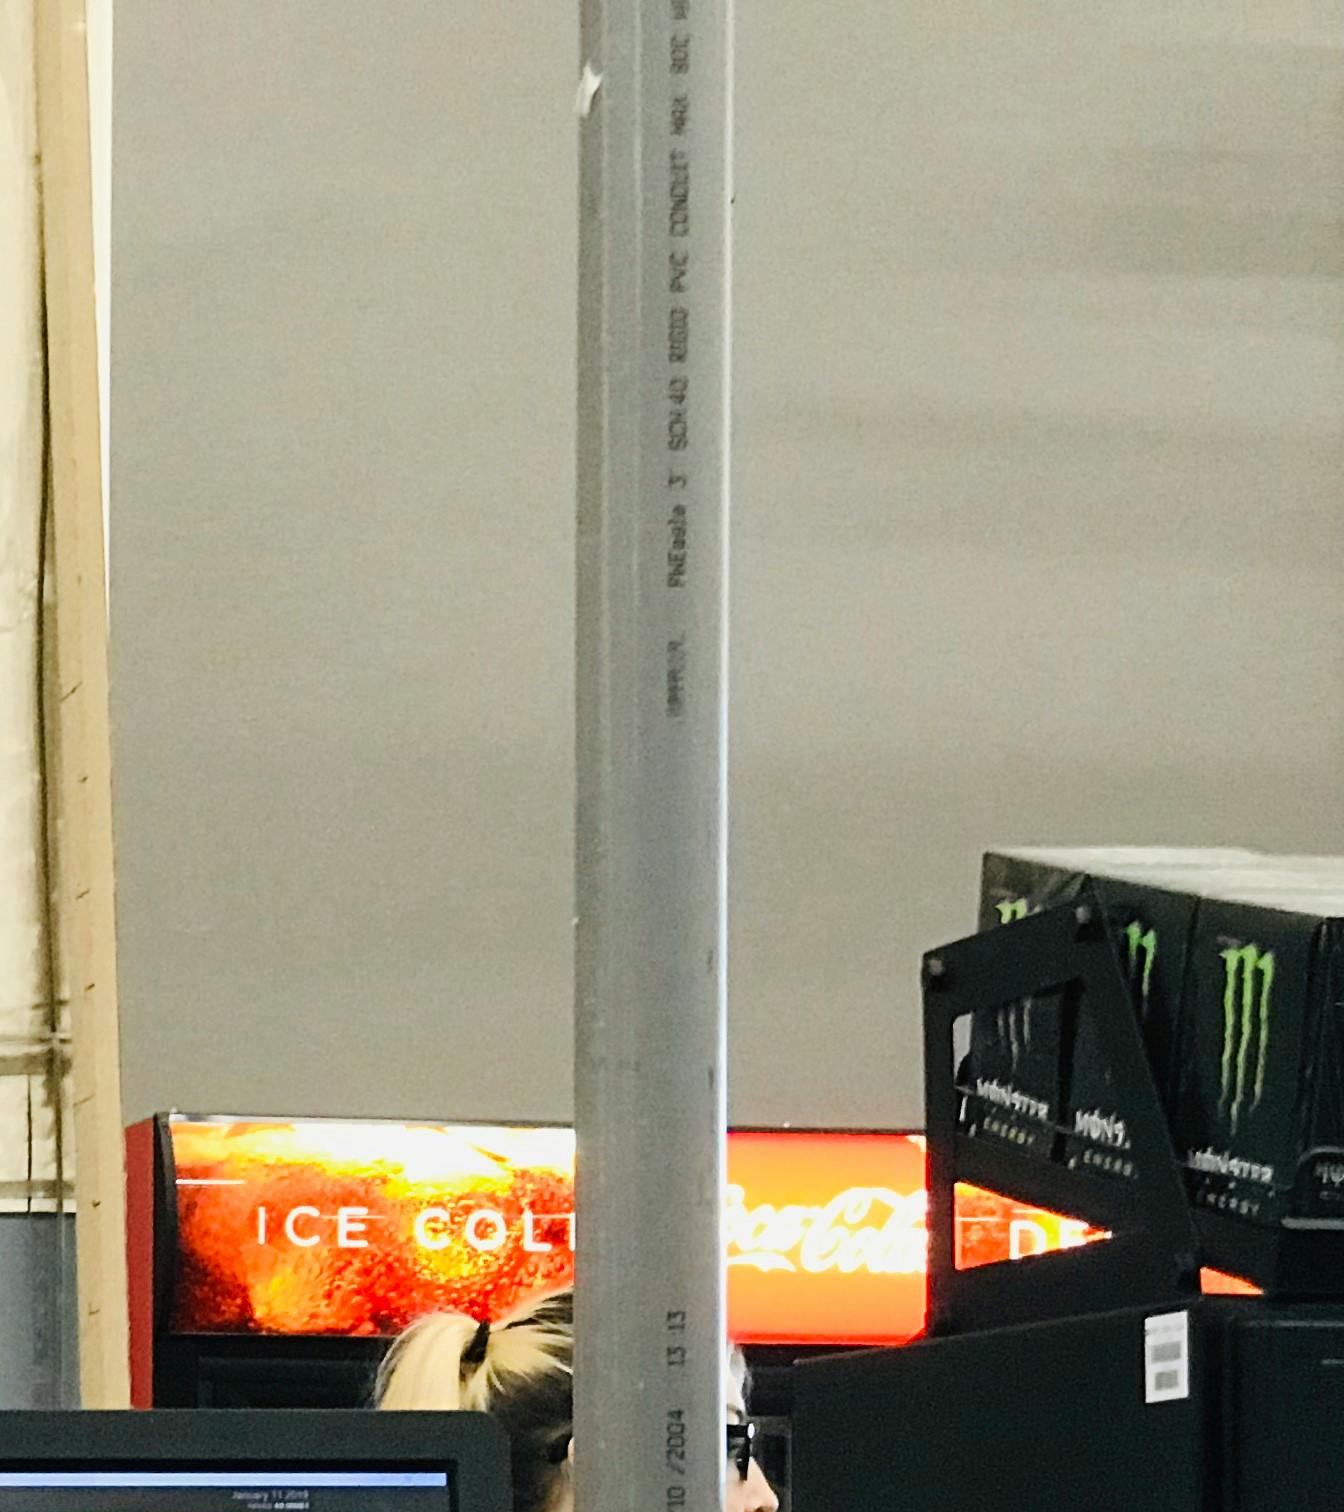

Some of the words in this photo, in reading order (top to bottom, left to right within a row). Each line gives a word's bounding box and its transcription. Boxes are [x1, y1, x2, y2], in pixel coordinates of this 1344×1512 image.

[667, 252, 689, 293] PVC
[257, 1206, 369, 1248] ICE
[413, 1207, 577, 1252] COL
